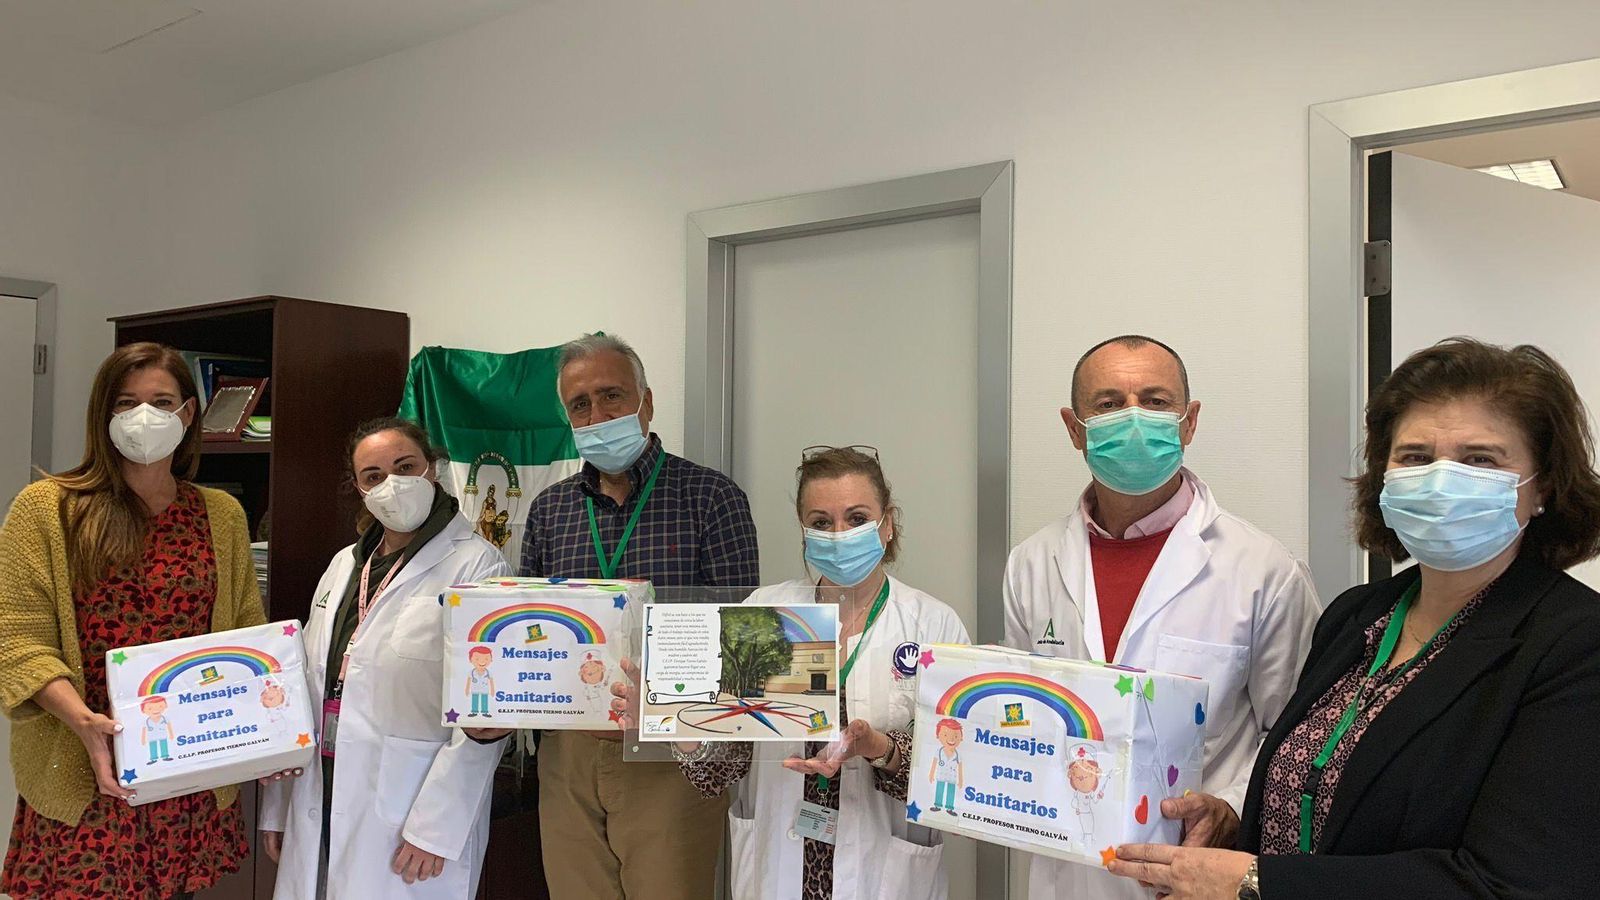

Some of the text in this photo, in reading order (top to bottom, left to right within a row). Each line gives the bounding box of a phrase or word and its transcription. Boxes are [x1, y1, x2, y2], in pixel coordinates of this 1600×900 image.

[502, 647, 568, 661] Mensajes
[518, 672, 551, 682] para
[178, 685, 248, 704] Mensajes
[495, 691, 573, 703] Sanitarios
[198, 708, 233, 724] para
[176, 723, 258, 746] Sanitarios
[975, 728, 1056, 756] Mensajes
[178, 737, 270, 760] C.E.I.P. PROFESOR TIERNO GALVÁN
[991, 764, 1033, 783] para
[964, 786, 1058, 820] Sanitarios
[962, 812, 1068, 842] C.E.I.P. PROFESOR TIERNO GALVÁN
